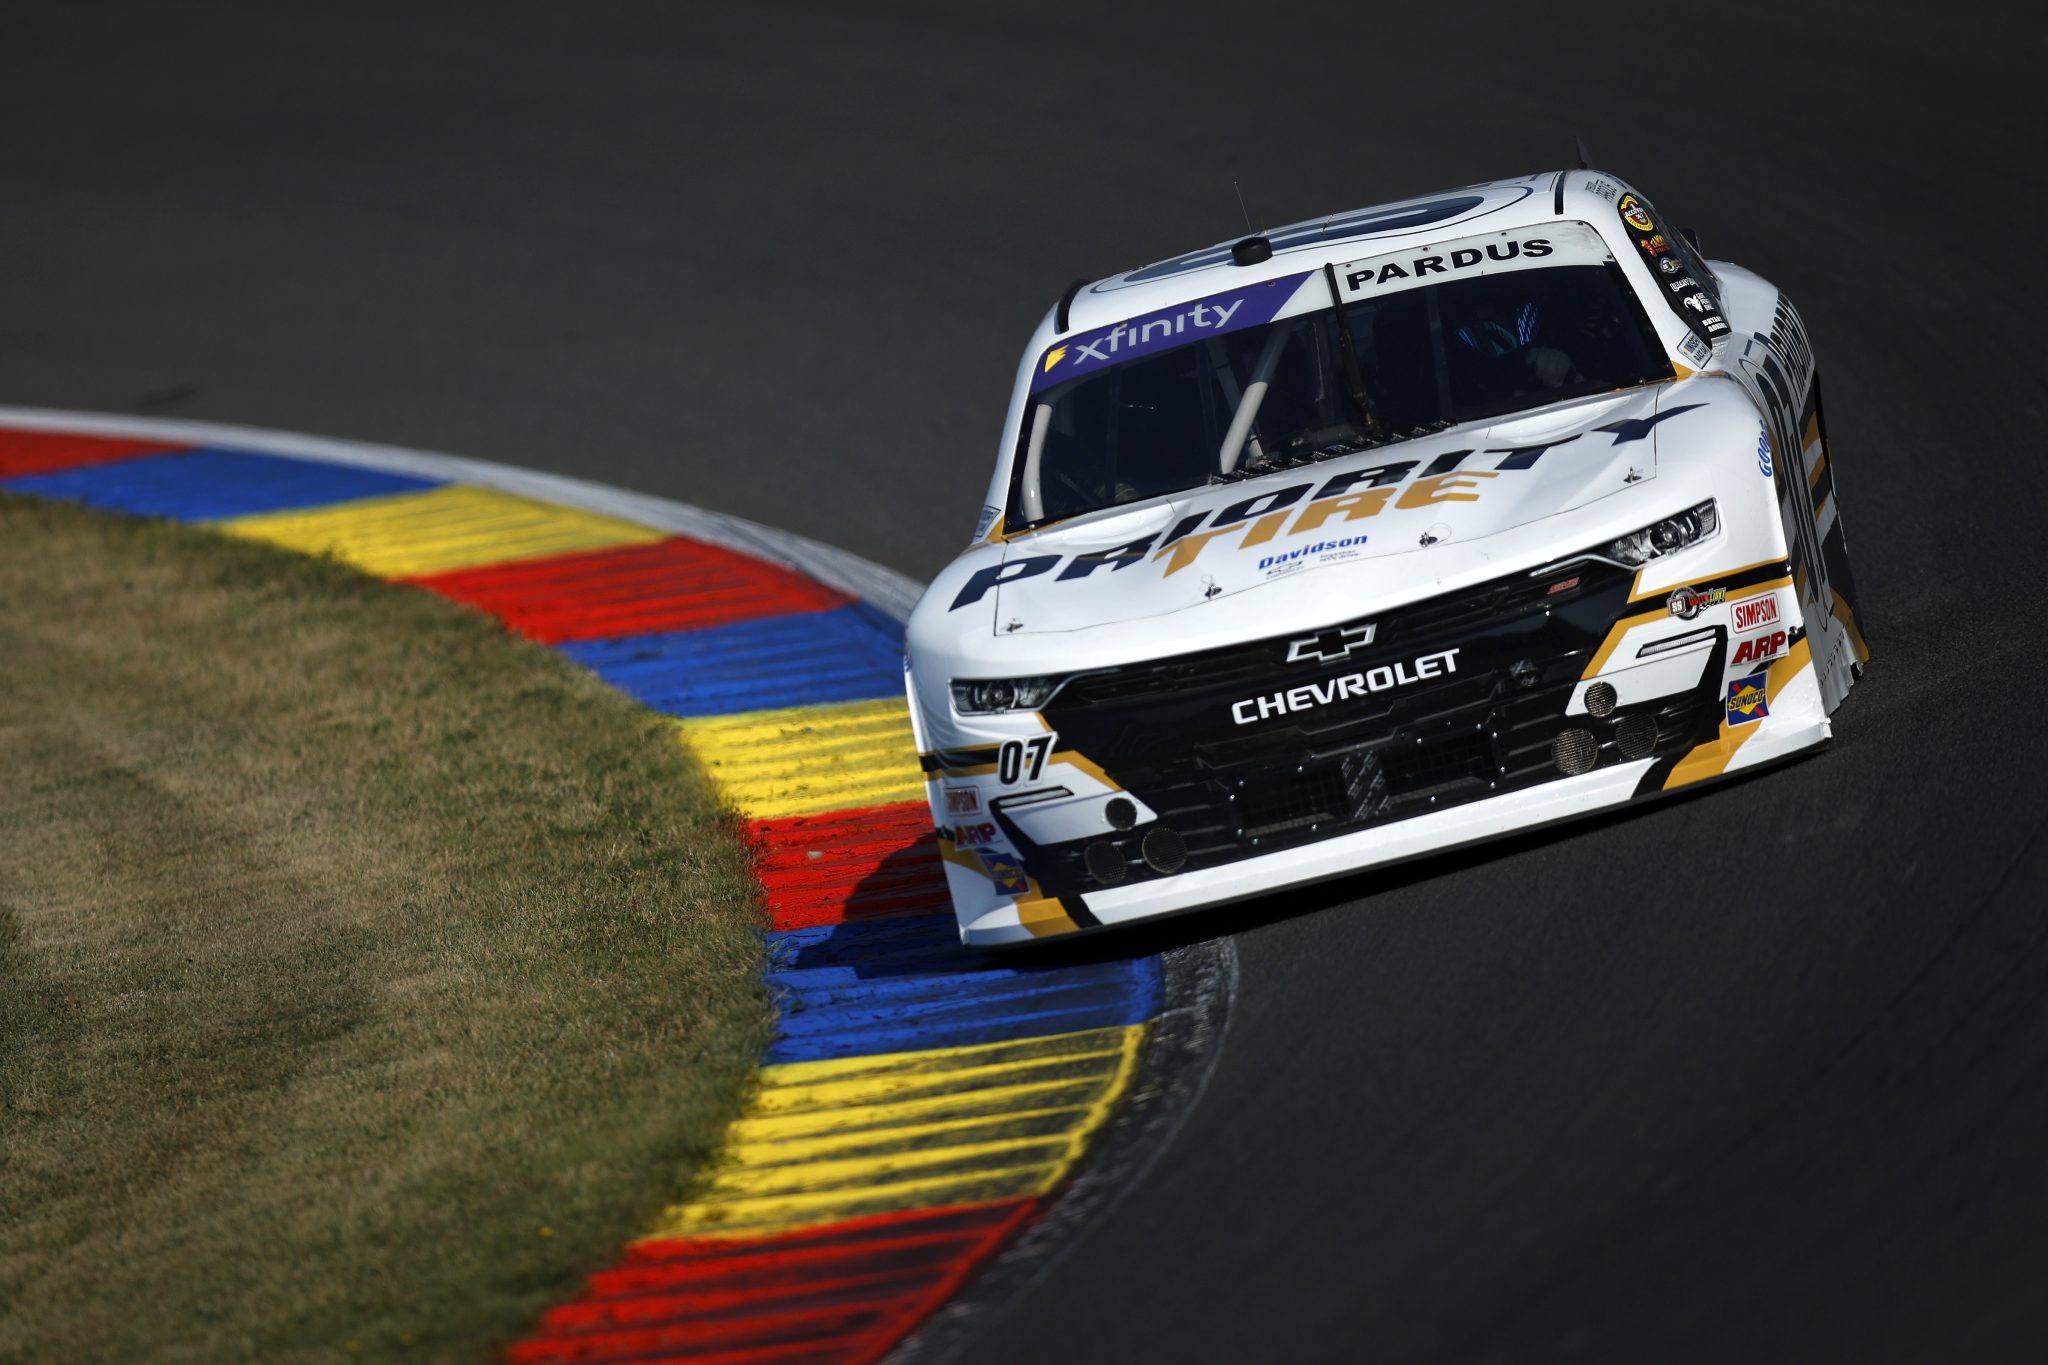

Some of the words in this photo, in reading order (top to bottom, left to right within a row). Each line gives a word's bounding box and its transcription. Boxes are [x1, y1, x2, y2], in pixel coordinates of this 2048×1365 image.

[1346, 238, 1554, 292] PARDUS
[1072, 298, 1245, 366] xfinity
[1754, 289, 1813, 408] PRIORIT
[947, 402, 1711, 613] PRIORITY
[1151, 470, 1500, 579] TIRE
[1258, 535, 1368, 571] Davidson
[1735, 596, 1777, 629] SIMPSON
[1731, 630, 1787, 665] ARP
[1231, 648, 1460, 726] CHEVROLET
[1728, 688, 1766, 712] SUNOCO
[999, 732, 1058, 788] 07
[955, 821, 997, 846] ARP
